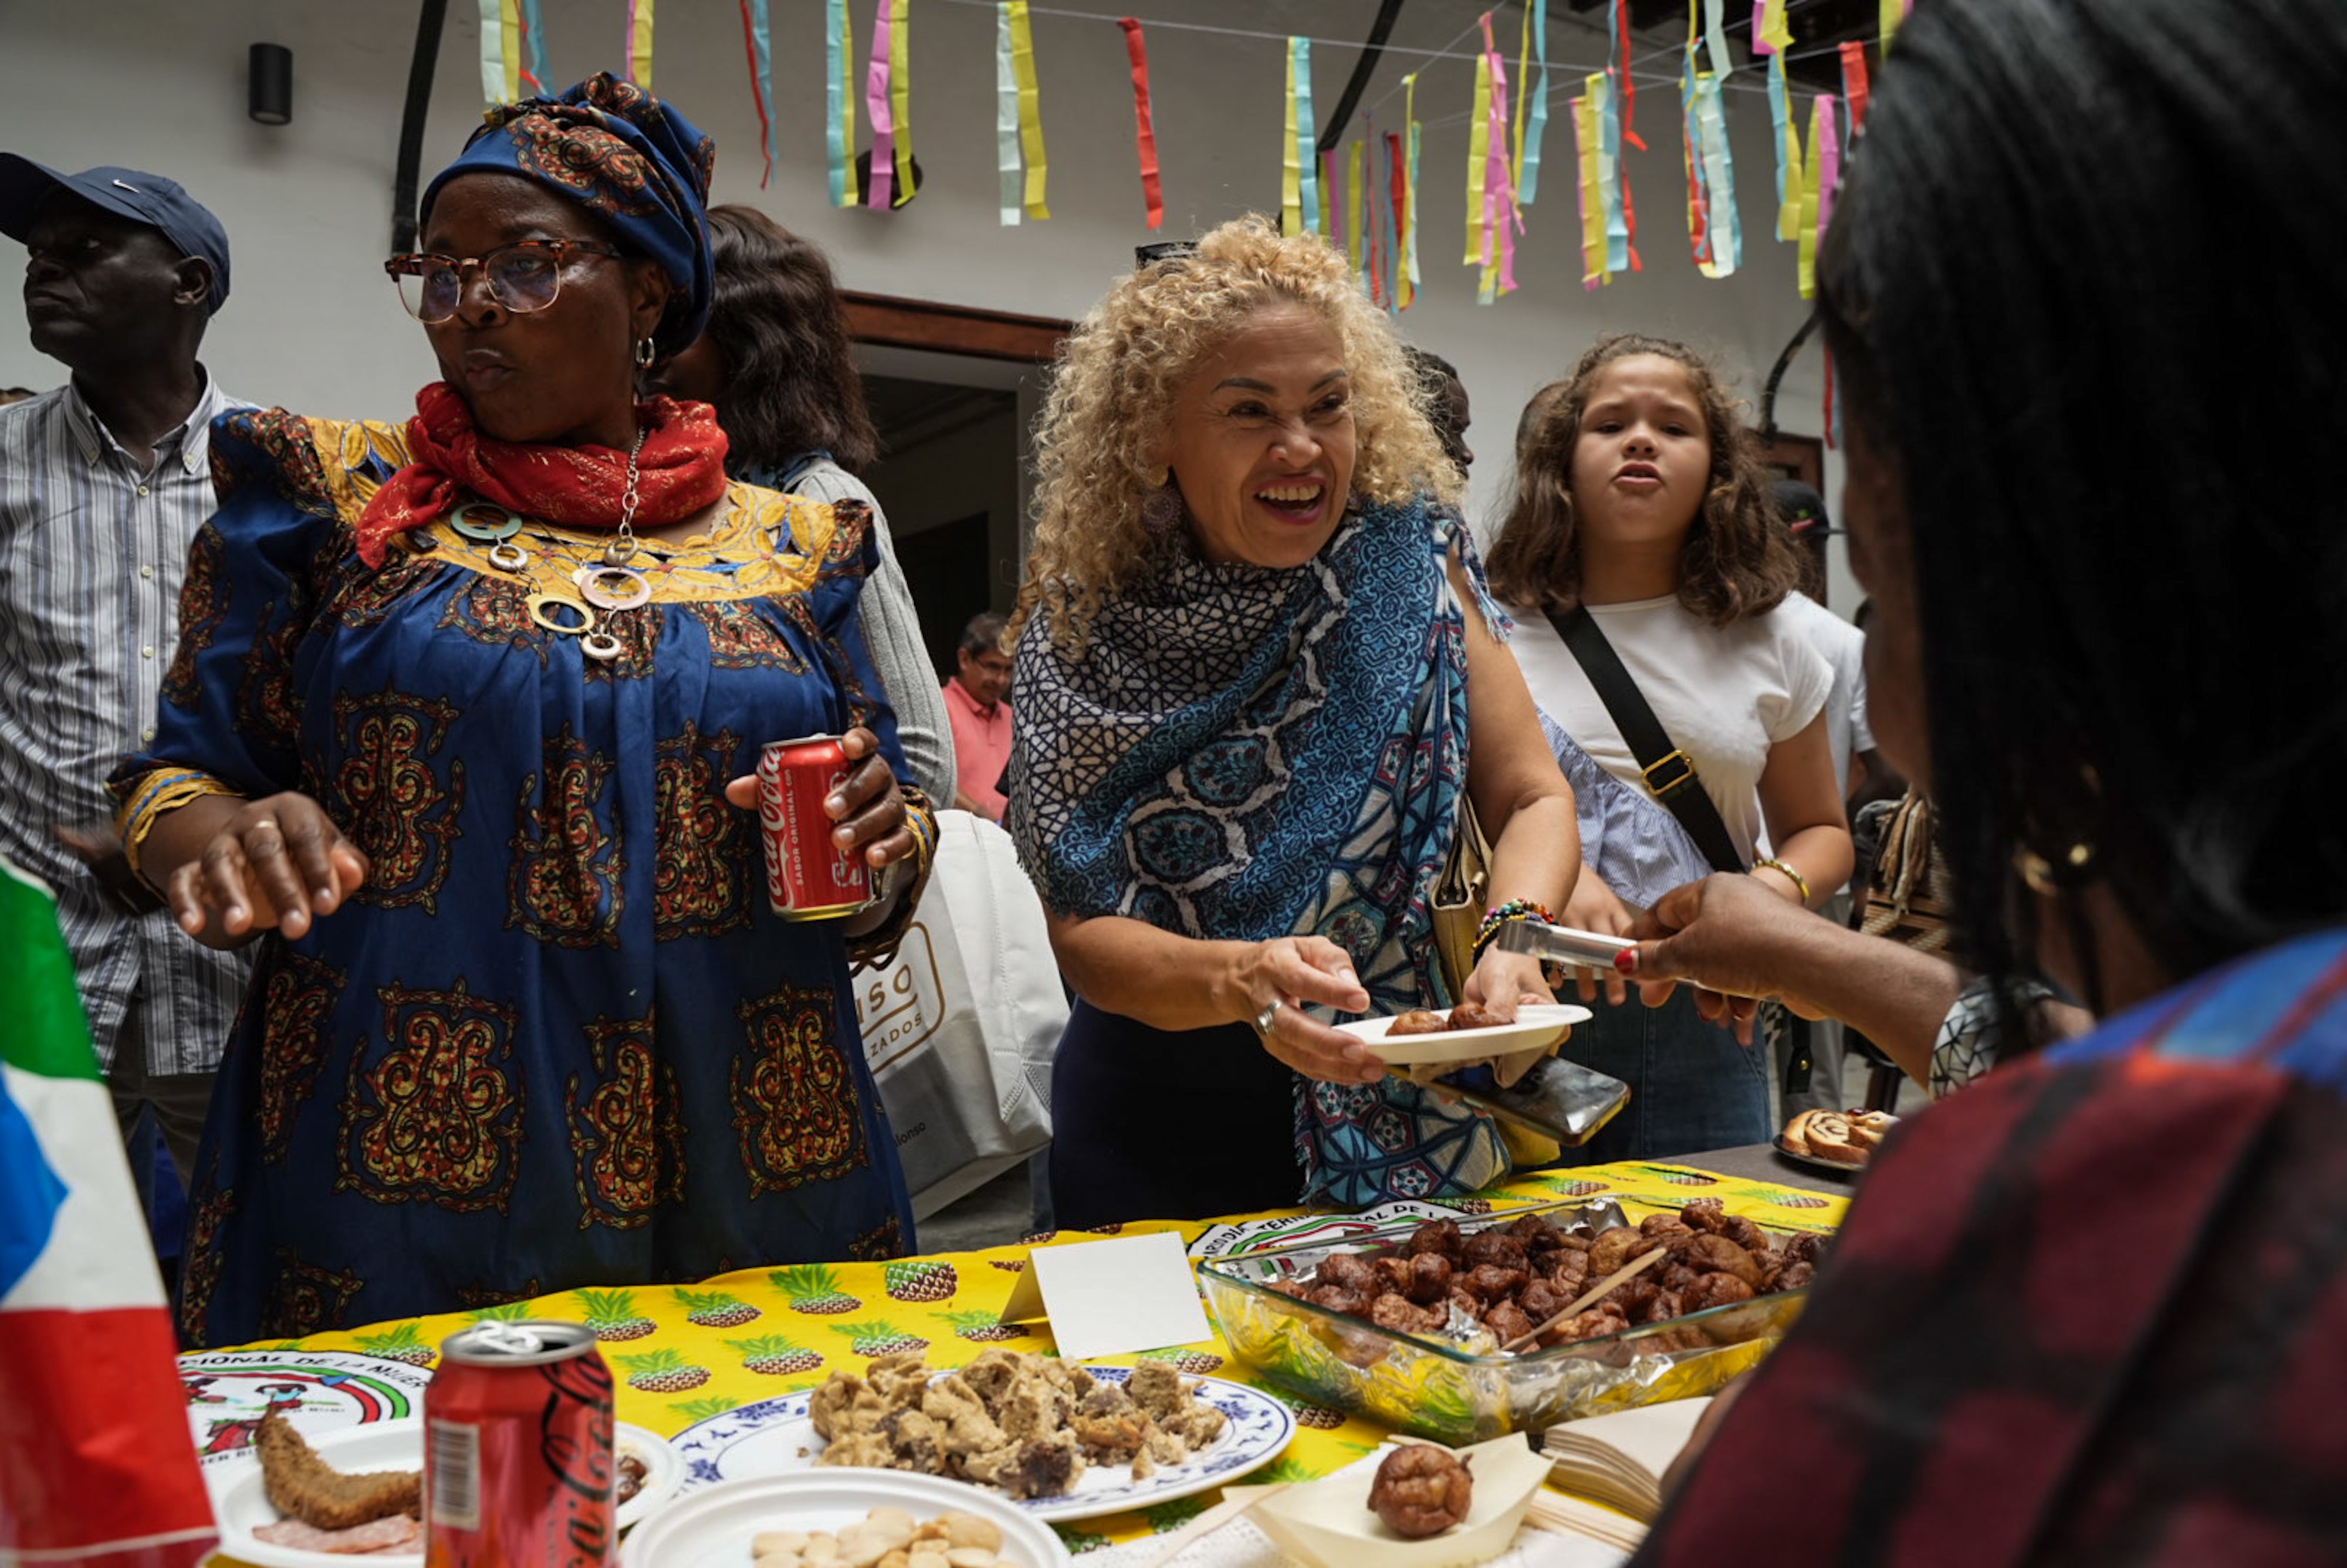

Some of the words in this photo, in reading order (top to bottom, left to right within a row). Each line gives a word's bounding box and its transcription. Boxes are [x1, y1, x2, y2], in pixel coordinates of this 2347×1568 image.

[787, 790, 799, 844] ORIGINAL
[793, 847, 804, 886] SABOR
[866, 1012, 922, 1061] ZADOS
[1394, 1204, 1421, 1214] DE
